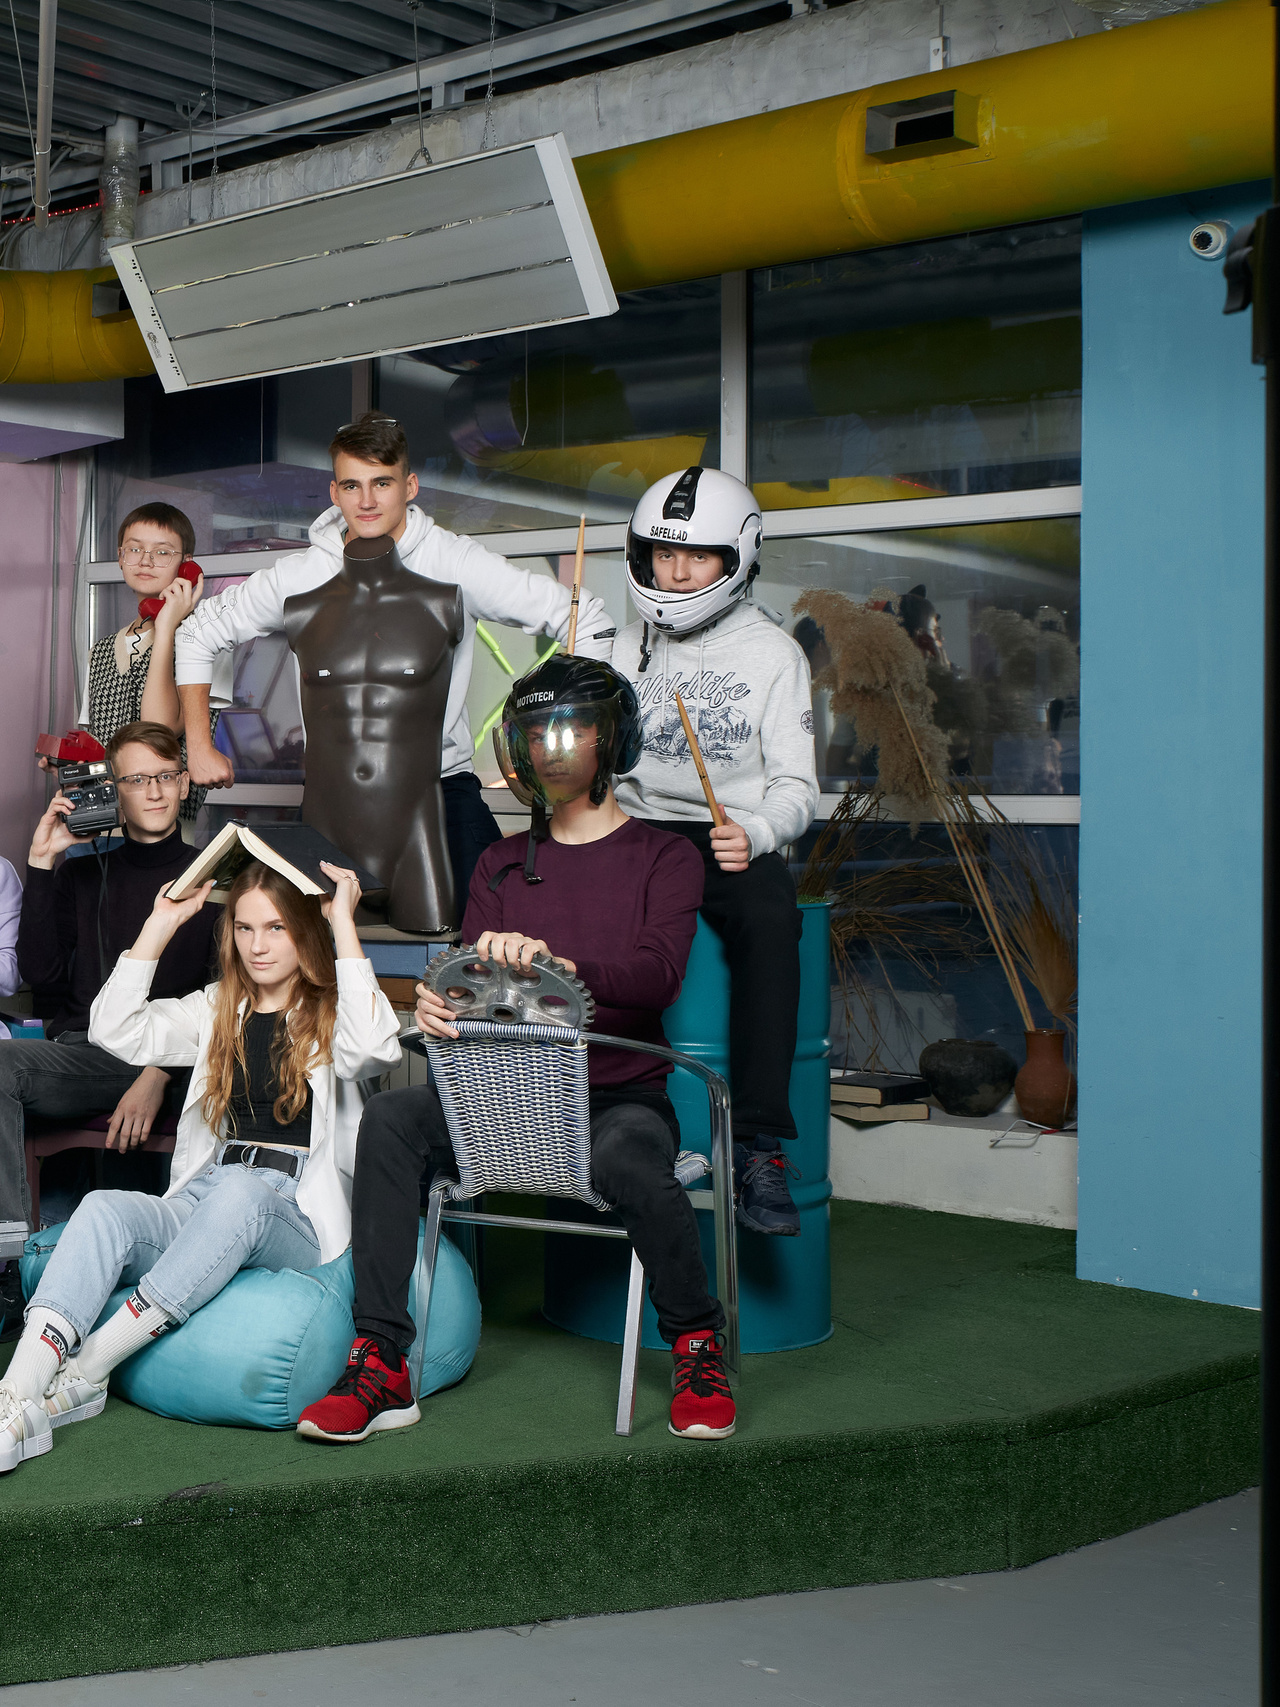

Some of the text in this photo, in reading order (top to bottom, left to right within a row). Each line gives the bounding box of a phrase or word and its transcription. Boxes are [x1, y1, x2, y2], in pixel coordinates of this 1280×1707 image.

[649, 525, 688, 542] SAFELEAD
[516, 690, 555, 709] MOTOTECH
[631, 671, 751, 709] Wildlife
[42, 1328, 66, 1357] Levi
